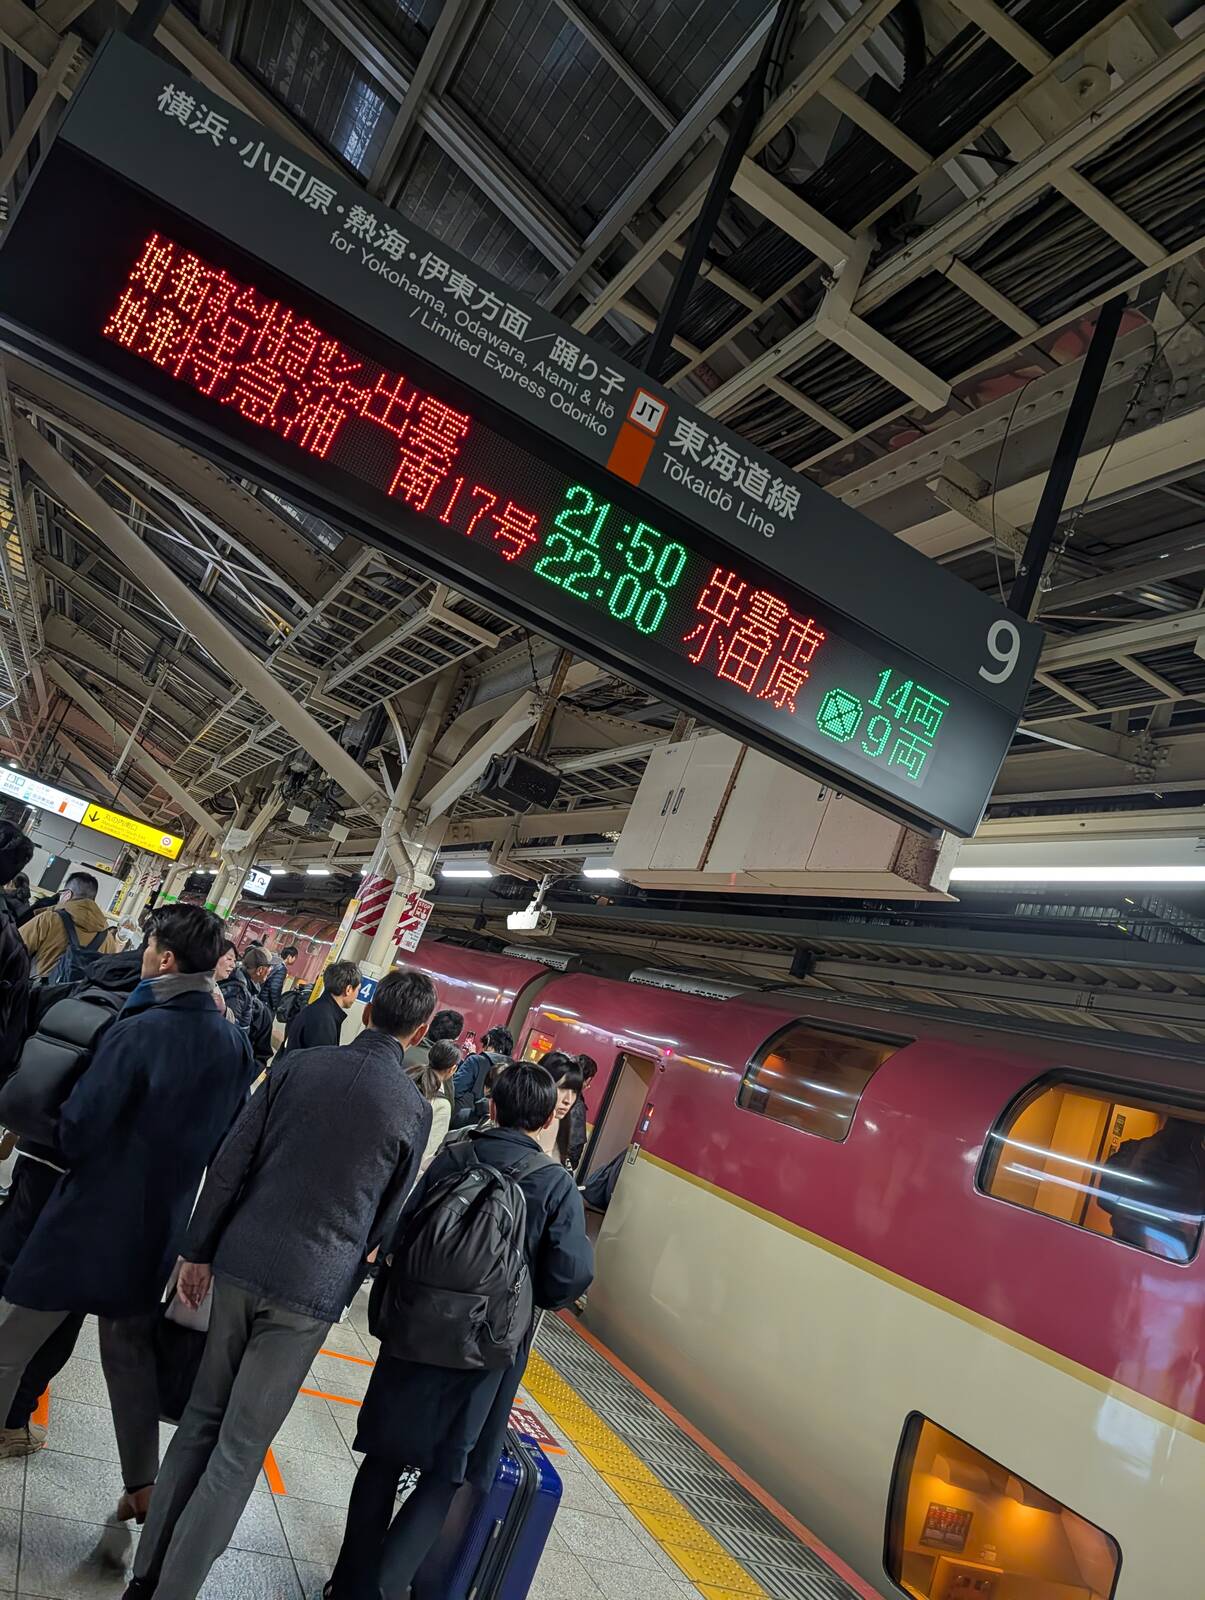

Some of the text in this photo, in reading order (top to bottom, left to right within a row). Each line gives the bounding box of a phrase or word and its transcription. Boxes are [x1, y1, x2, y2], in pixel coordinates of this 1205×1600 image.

[330, 231, 616, 420] for Yokohama, Odawara, Atami & Itō
[420, 311, 479, 358] Limited
[483, 353, 546, 399] Express
[549, 392, 608, 436] Odoriko
[635, 401, 660, 422] JT
[661, 452, 776, 538] Tōkaidō Line
[669, 415, 802, 521] 東海道線
[533, 532, 669, 636] 22:00
[683, 618, 810, 714] 小田原
[861, 714, 934, 781] 9両
[553, 484, 688, 589] 21:50
[696, 567, 826, 663] 出雲市
[868, 667, 950, 739] 14両
[978, 619, 1021, 684] 9
[418, 900, 431, 910] STOP
[360, 983, 371, 998] 4
